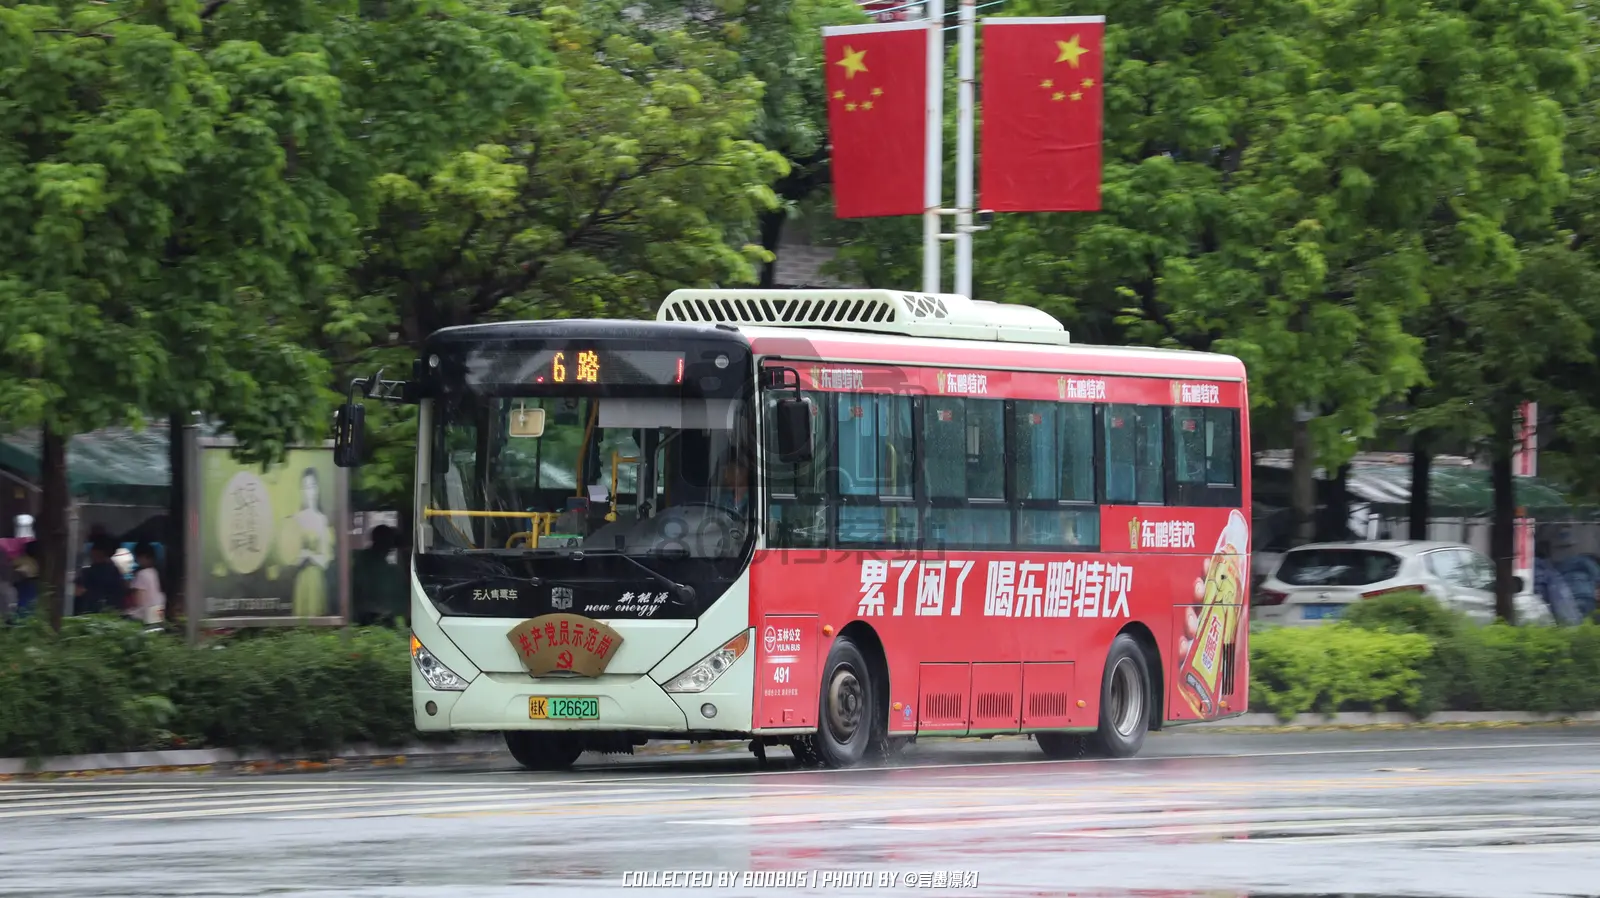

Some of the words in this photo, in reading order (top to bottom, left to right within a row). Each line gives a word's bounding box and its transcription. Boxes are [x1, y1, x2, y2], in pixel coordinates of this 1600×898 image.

[553, 352, 565, 382] 6
[577, 351, 600, 382] 路
[821, 368, 864, 390] 东鹏特饮
[947, 372, 988, 394] 东鹏特饮
[1067, 378, 1106, 400] 东鹏特饮
[1182, 383, 1220, 404] 东鹏特饮
[1142, 520, 1195, 549] 东鹏特饮
[473, 589, 518, 602] 无人售票车
[618, 591, 670, 605] 新能源
[857, 559, 972, 616] 累了困了
[984, 560, 1133, 618] 喝东鹏特饮
[584, 604, 611, 613] new
[615, 604, 660, 617] energy
[519, 620, 613, 658] 共产党员示范岗
[777, 628, 801, 641] 玉林公交
[777, 644, 791, 652] YULIN
[791, 643, 801, 651] BUS
[773, 667, 790, 683] 491
[531, 700, 546, 716] 桂K
[552, 700, 598, 716] 12662D
